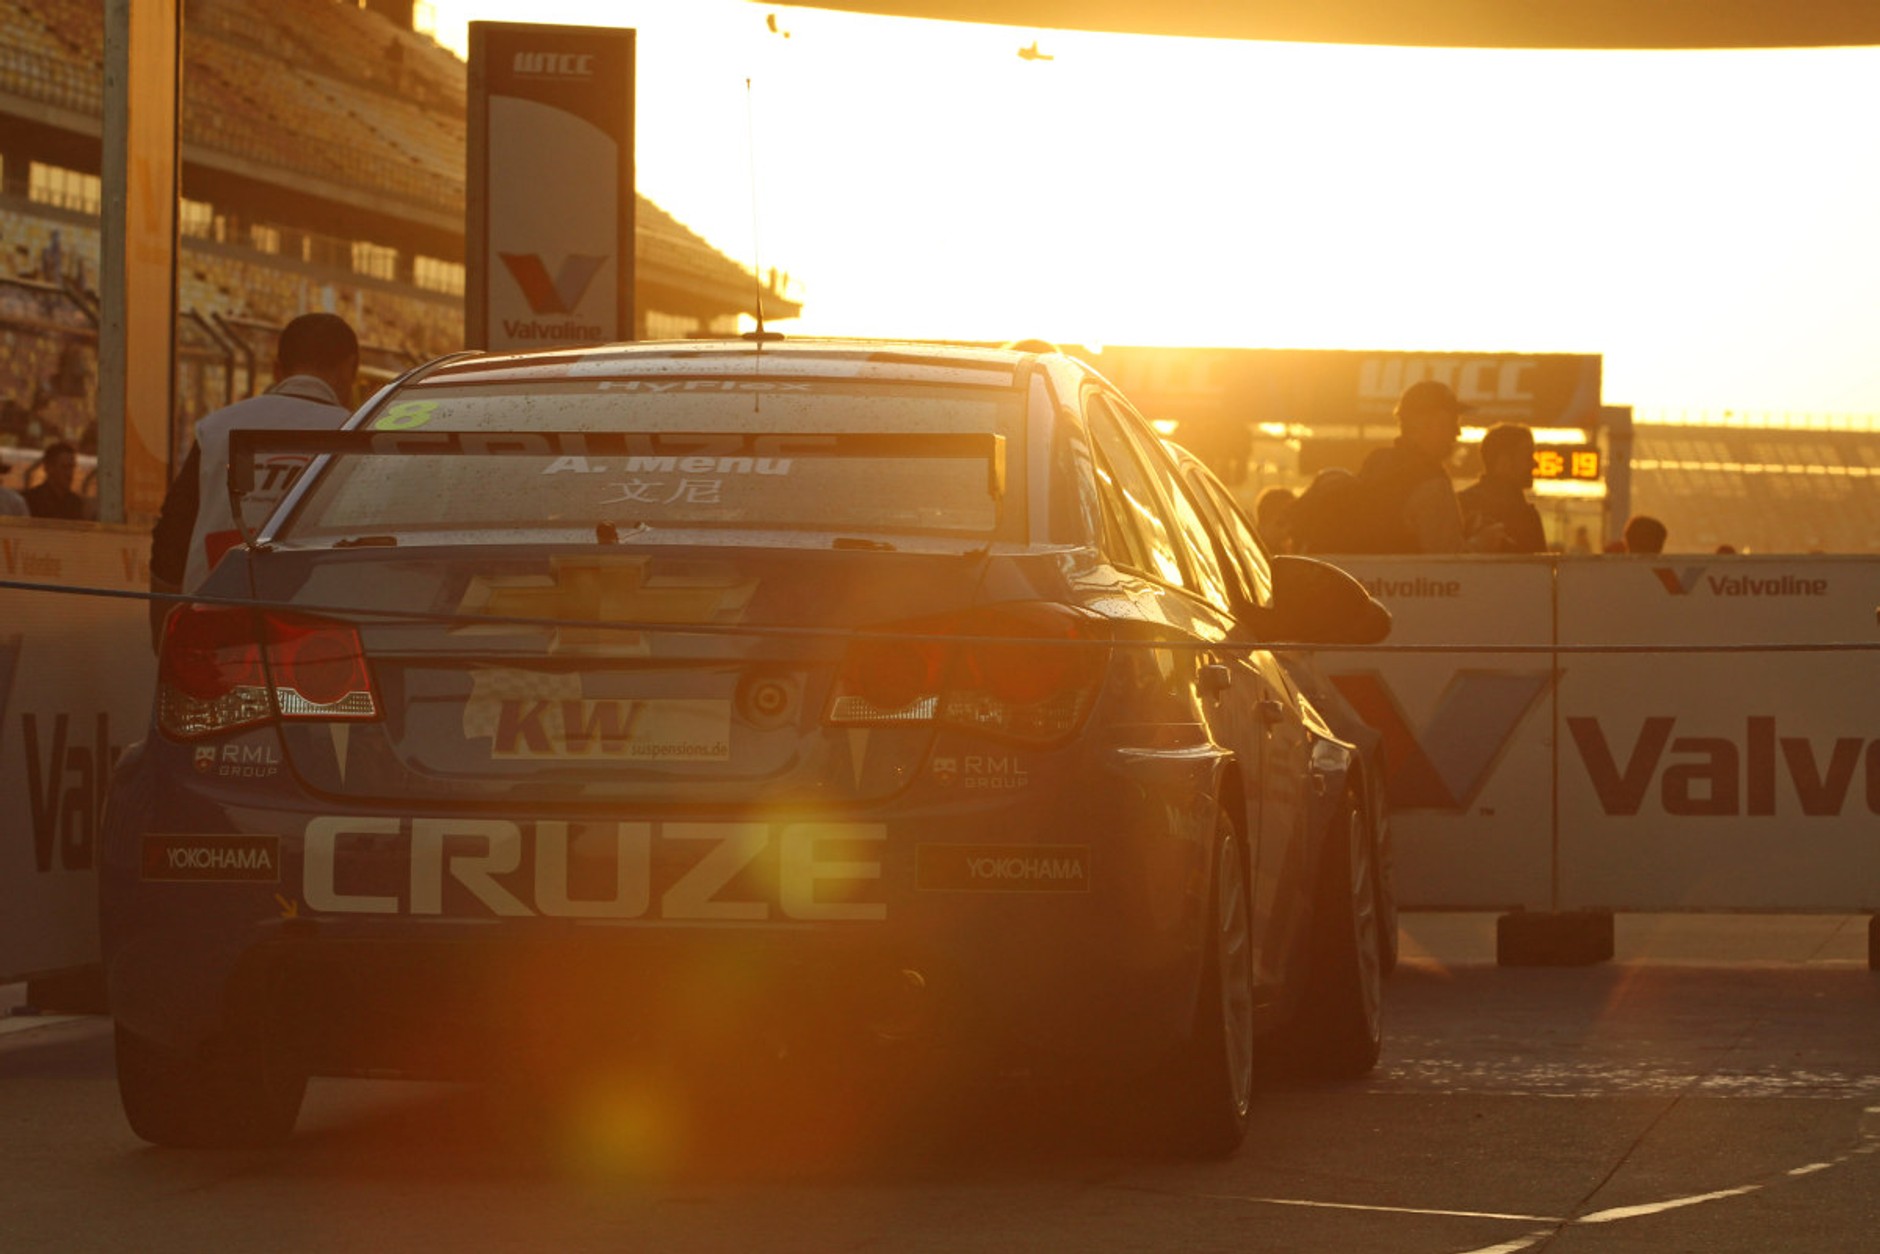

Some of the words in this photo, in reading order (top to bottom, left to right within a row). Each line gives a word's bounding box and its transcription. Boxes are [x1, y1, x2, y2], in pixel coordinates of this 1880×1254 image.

[513, 51, 594, 75] WTCC
[503, 319, 602, 341] Valvoline
[1357, 358, 1539, 401] WTCC
[374, 399, 438, 431] 8
[542, 455, 606, 475] A.
[625, 455, 795, 476] Menu
[600, 478, 722, 505] 文尼
[1360, 577, 1461, 598] alvoline
[1707, 575, 1829, 597] Valvoline
[493, 698, 647, 756] KW
[221, 744, 279, 764] RML
[631, 740, 728, 758] suspensions.de
[218, 765, 278, 778] GROUP
[964, 756, 1029, 775] RML
[1565, 715, 1880, 817] Valv
[21, 711, 123, 873] Val
[964, 776, 1029, 789] GROUP
[166, 847, 272, 869] YOKOHAMA
[303, 815, 888, 920] CRUZE
[966, 857, 1083, 880] YOKOHAMA
